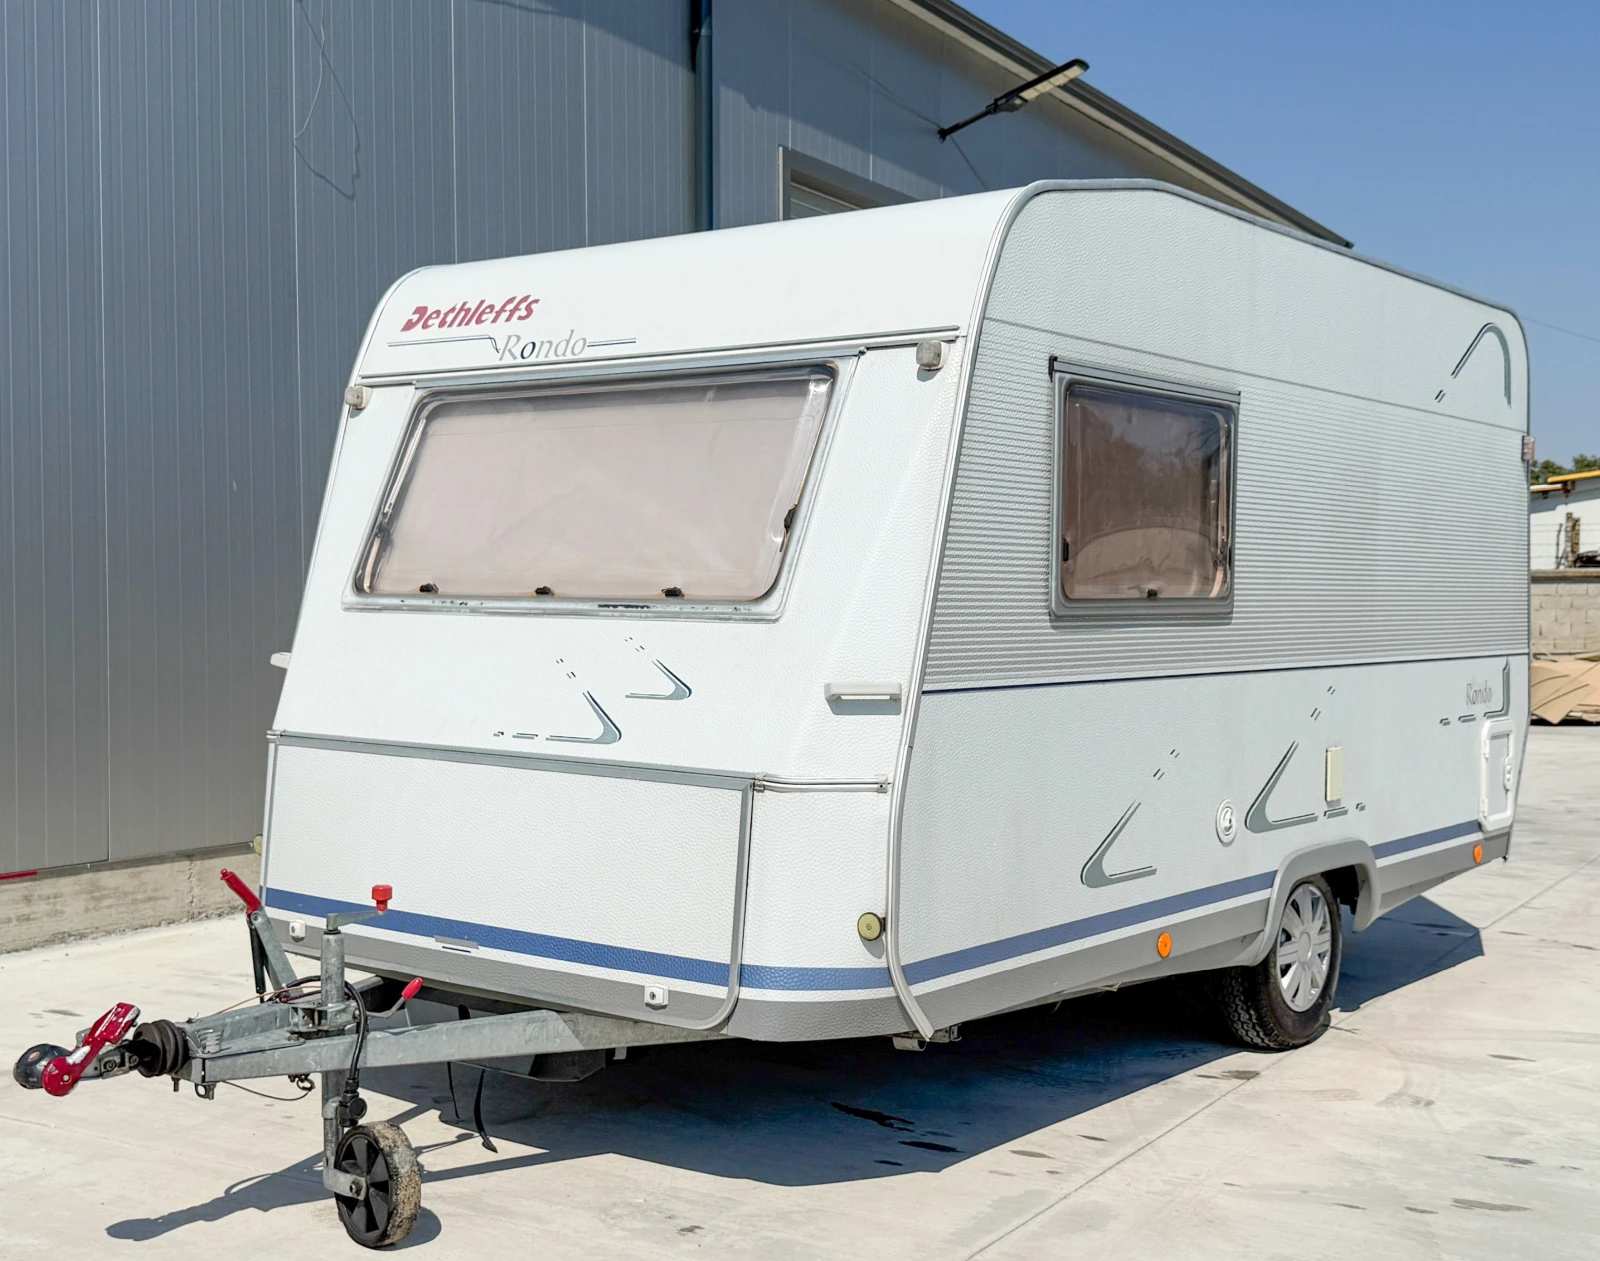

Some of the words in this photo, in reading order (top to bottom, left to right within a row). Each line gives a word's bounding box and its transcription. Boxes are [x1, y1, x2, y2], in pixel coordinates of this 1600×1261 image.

[400, 294, 541, 332] Dethleffs
[499, 329, 588, 361] Rondo
[1466, 680, 1493, 706] Rondo
